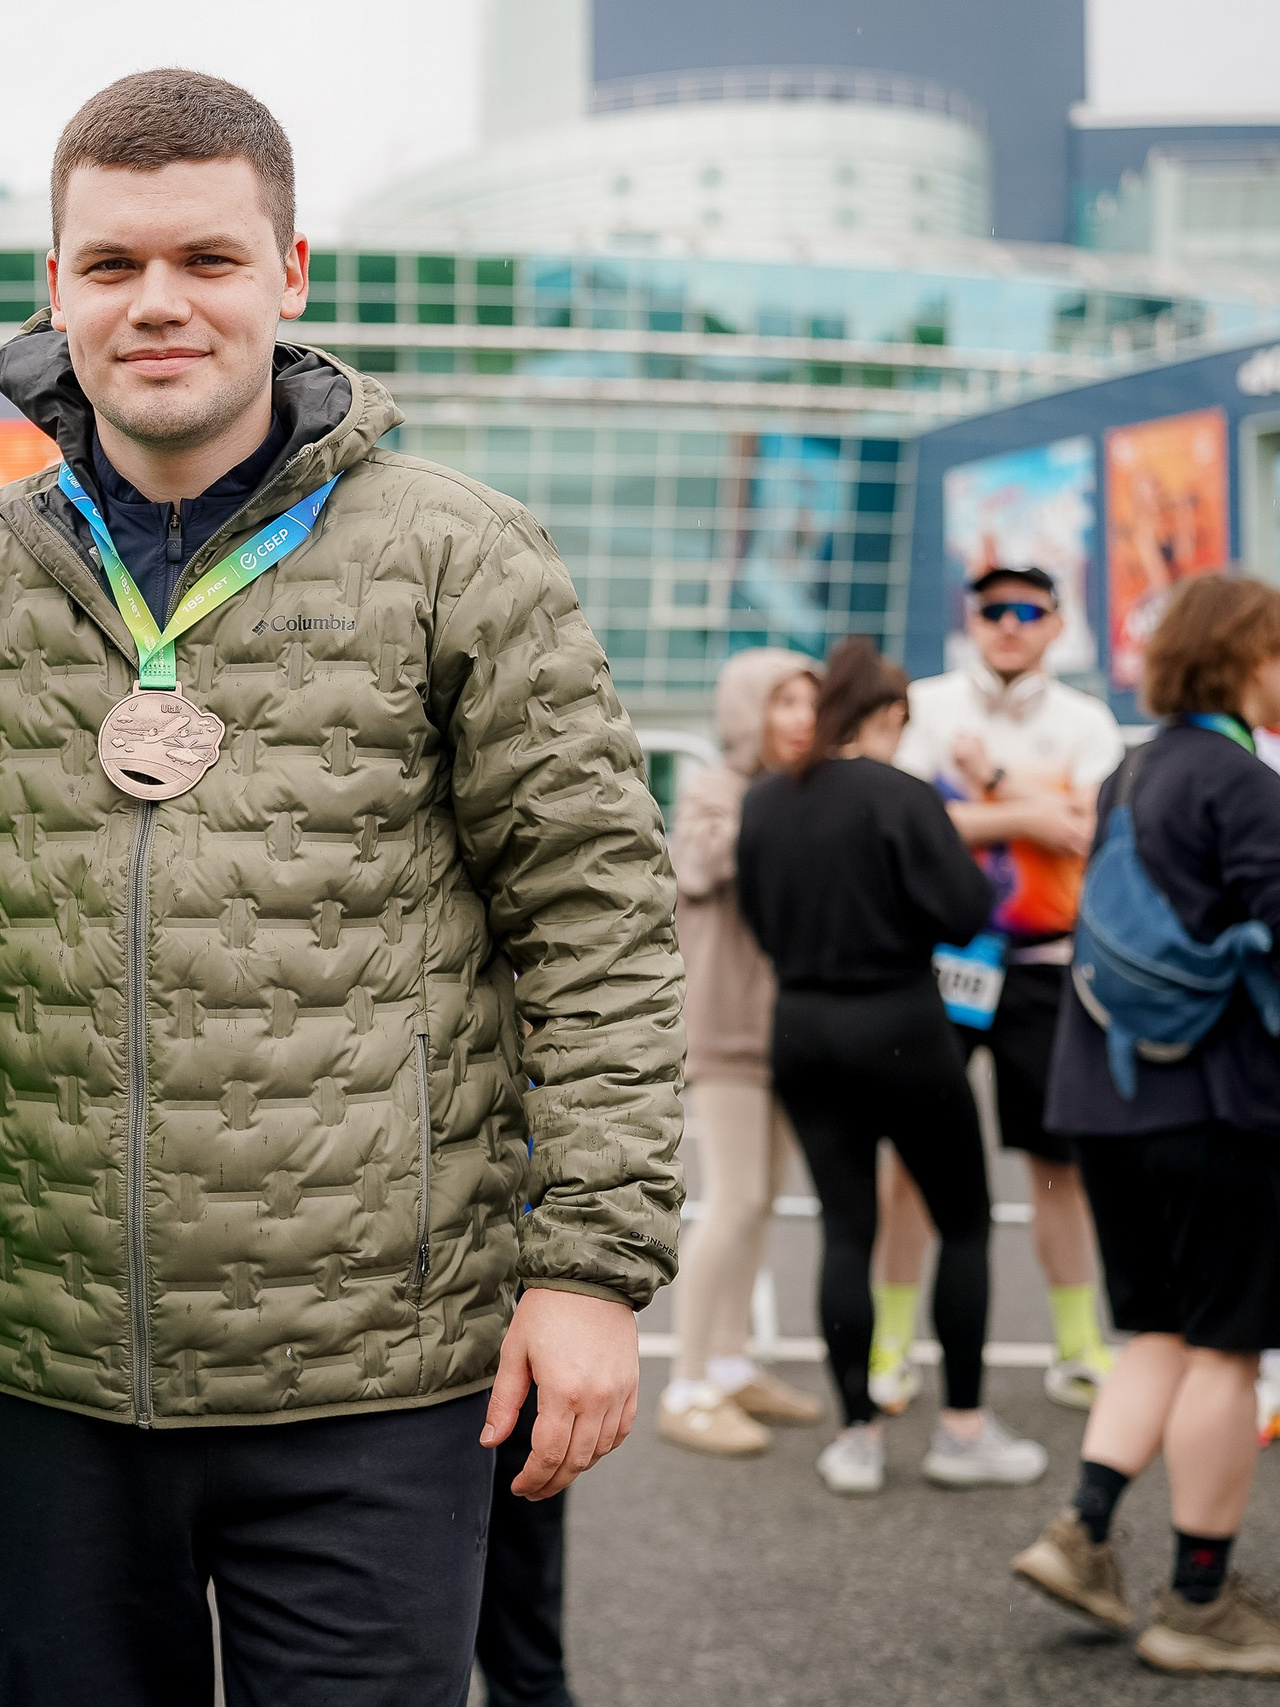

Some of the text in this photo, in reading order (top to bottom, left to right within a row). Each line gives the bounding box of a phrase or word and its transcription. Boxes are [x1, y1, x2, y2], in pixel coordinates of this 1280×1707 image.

[182, 528, 289, 613] 185 лет СБЕР
[119, 571, 141, 618] 185 лет
[270, 614, 356, 632] Columbia
